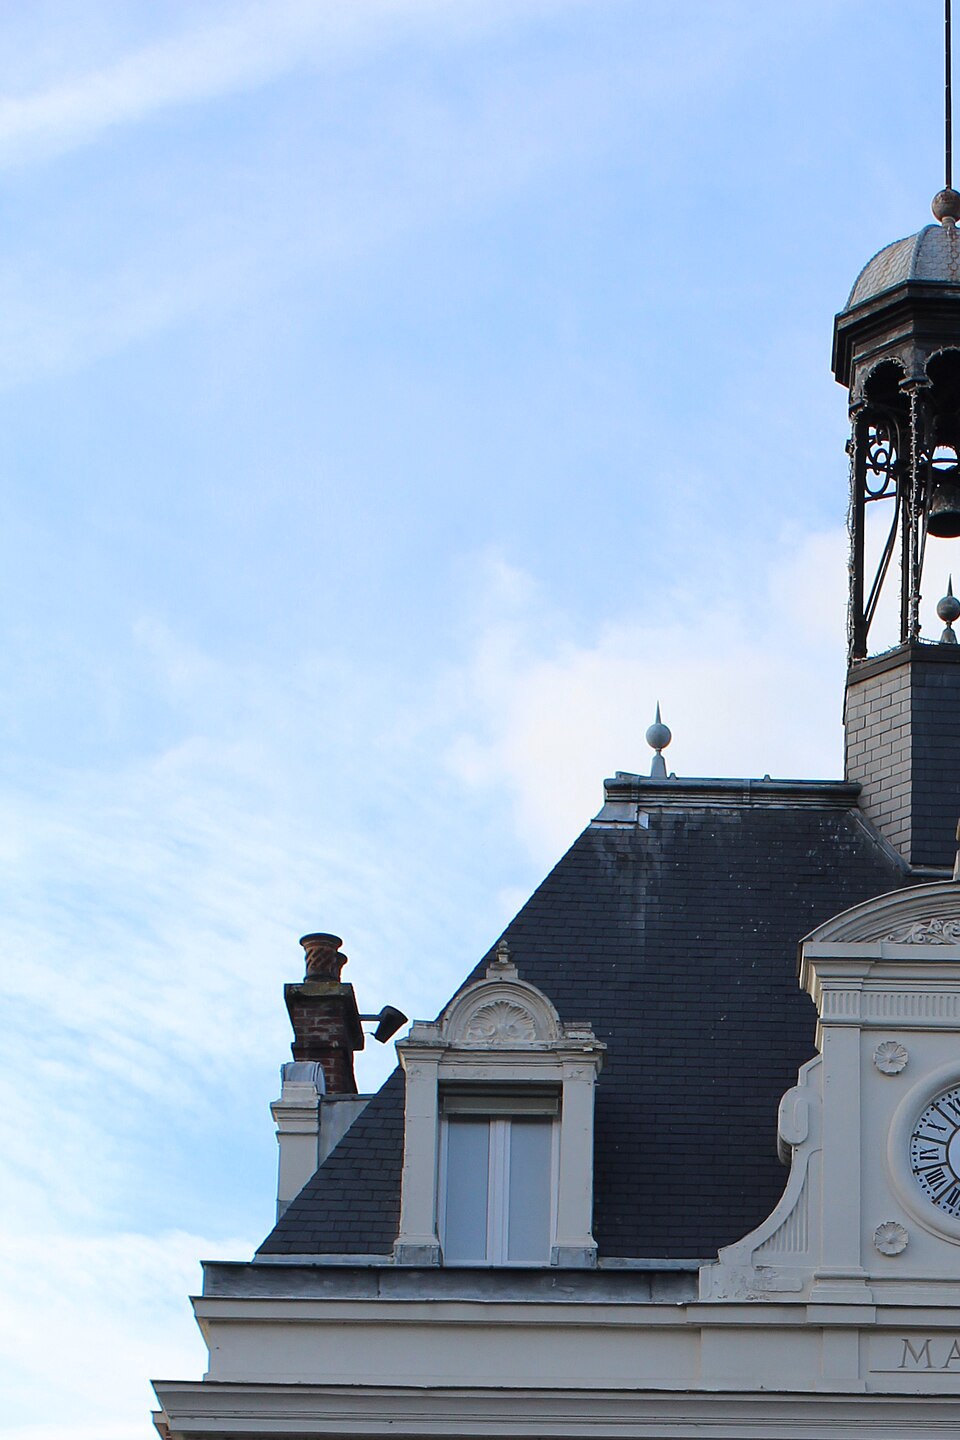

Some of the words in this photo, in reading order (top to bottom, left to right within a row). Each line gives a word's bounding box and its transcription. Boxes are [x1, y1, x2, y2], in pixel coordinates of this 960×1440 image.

[926, 1119, 947, 1136] X
[919, 1146, 939, 1161] IX
[925, 1167, 948, 1192] VIII
